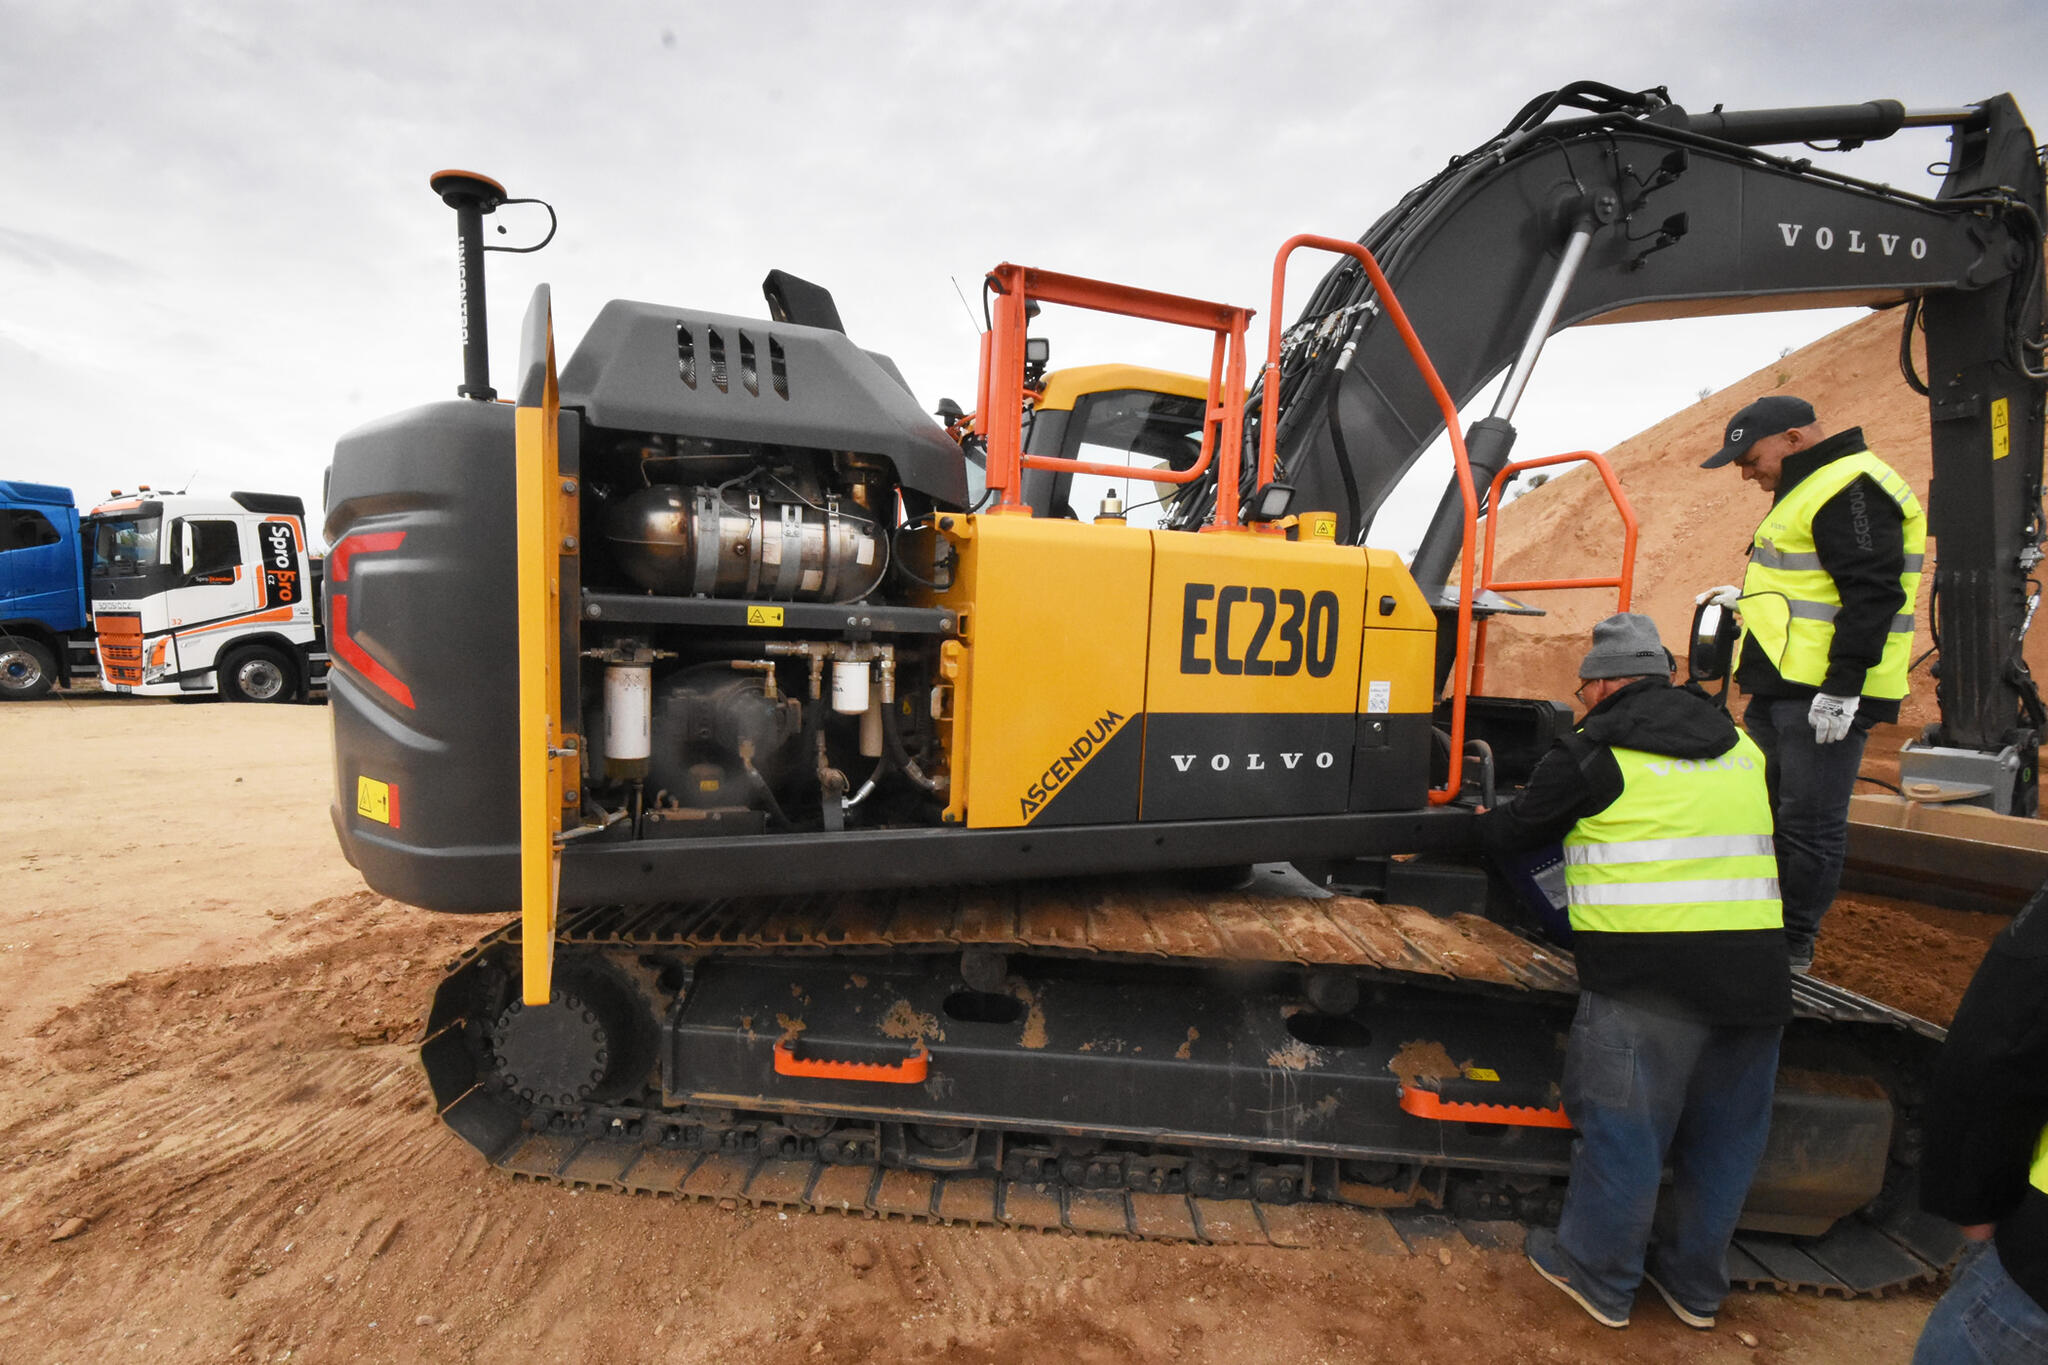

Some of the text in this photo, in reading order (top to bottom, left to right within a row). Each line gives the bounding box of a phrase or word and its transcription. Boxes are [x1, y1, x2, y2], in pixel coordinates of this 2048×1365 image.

[1778, 222, 1928, 260] VOLVO
[268, 526, 290, 568] Spro
[1179, 581, 1340, 679] EC230
[1020, 709, 1125, 820] ASCENDUM
[1170, 751, 1335, 773] VOLVO
[1644, 755, 1754, 777] VOLVO
